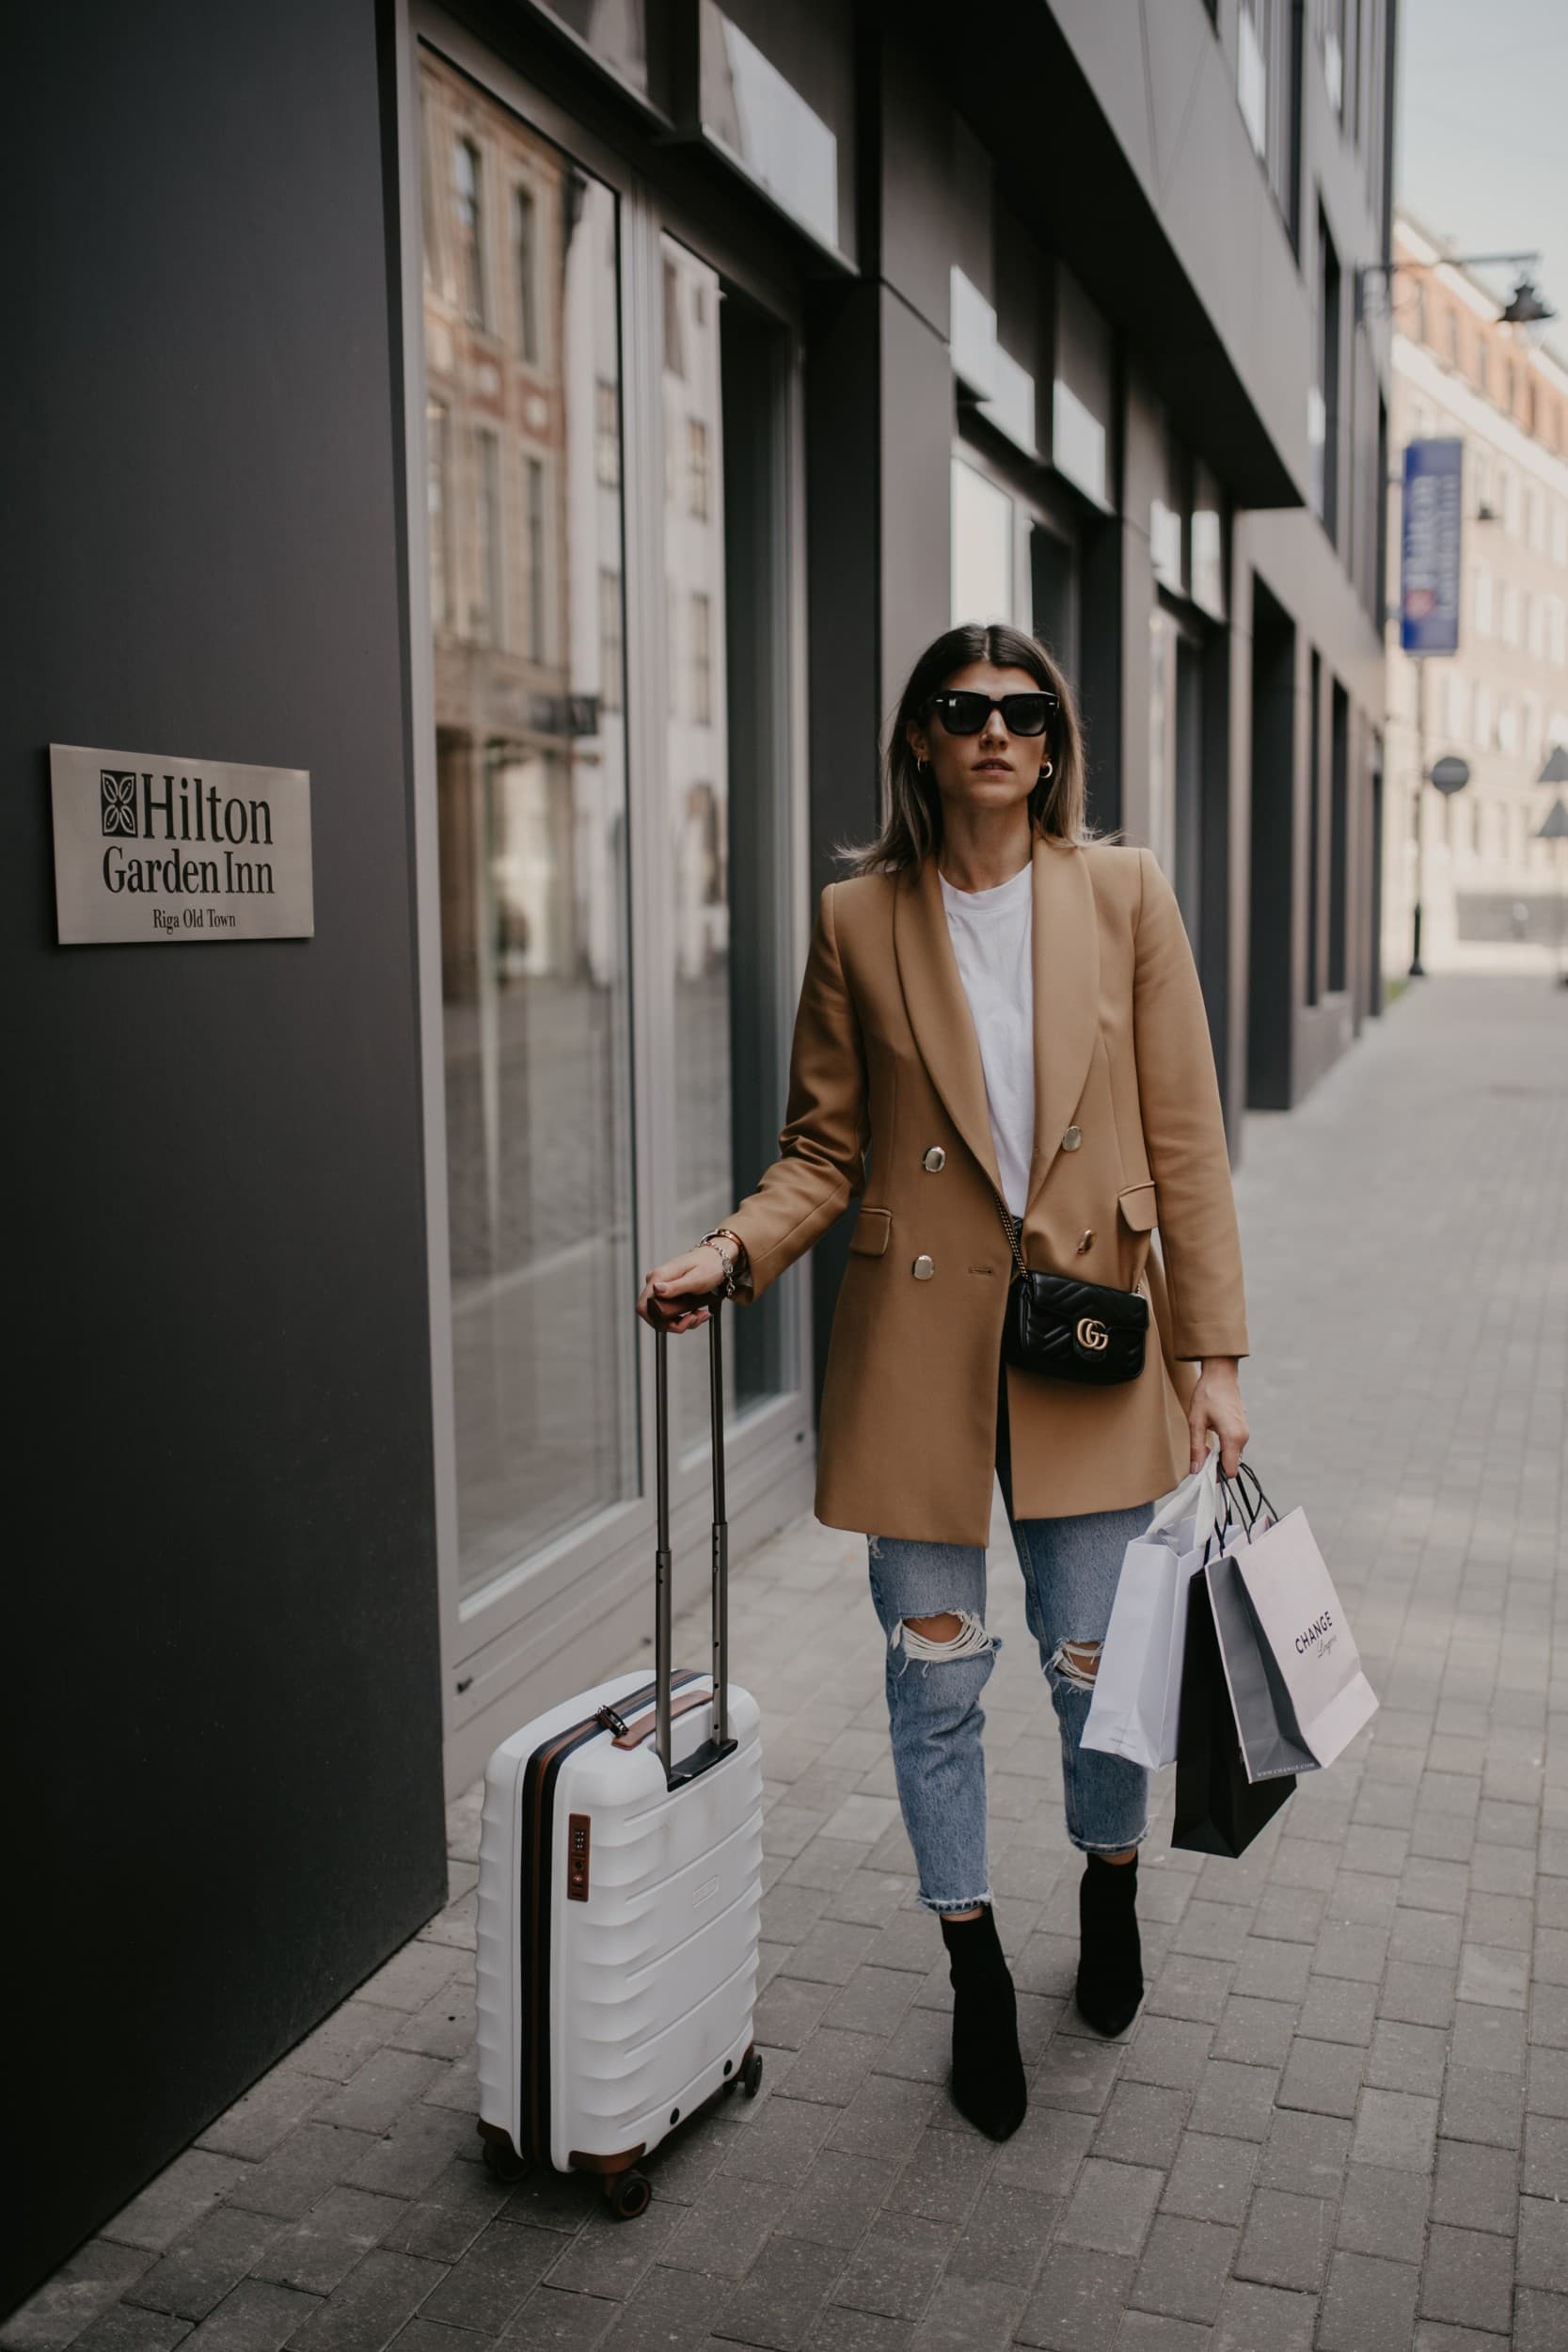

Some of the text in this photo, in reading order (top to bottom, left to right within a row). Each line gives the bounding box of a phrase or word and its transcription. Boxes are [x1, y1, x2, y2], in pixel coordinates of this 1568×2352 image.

[142, 773, 273, 844] Hilton
[103, 846, 275, 894] Garden Inn
[153, 909, 236, 934] Riga Old Town
[1295, 1611, 1333, 1654] CHANGE
